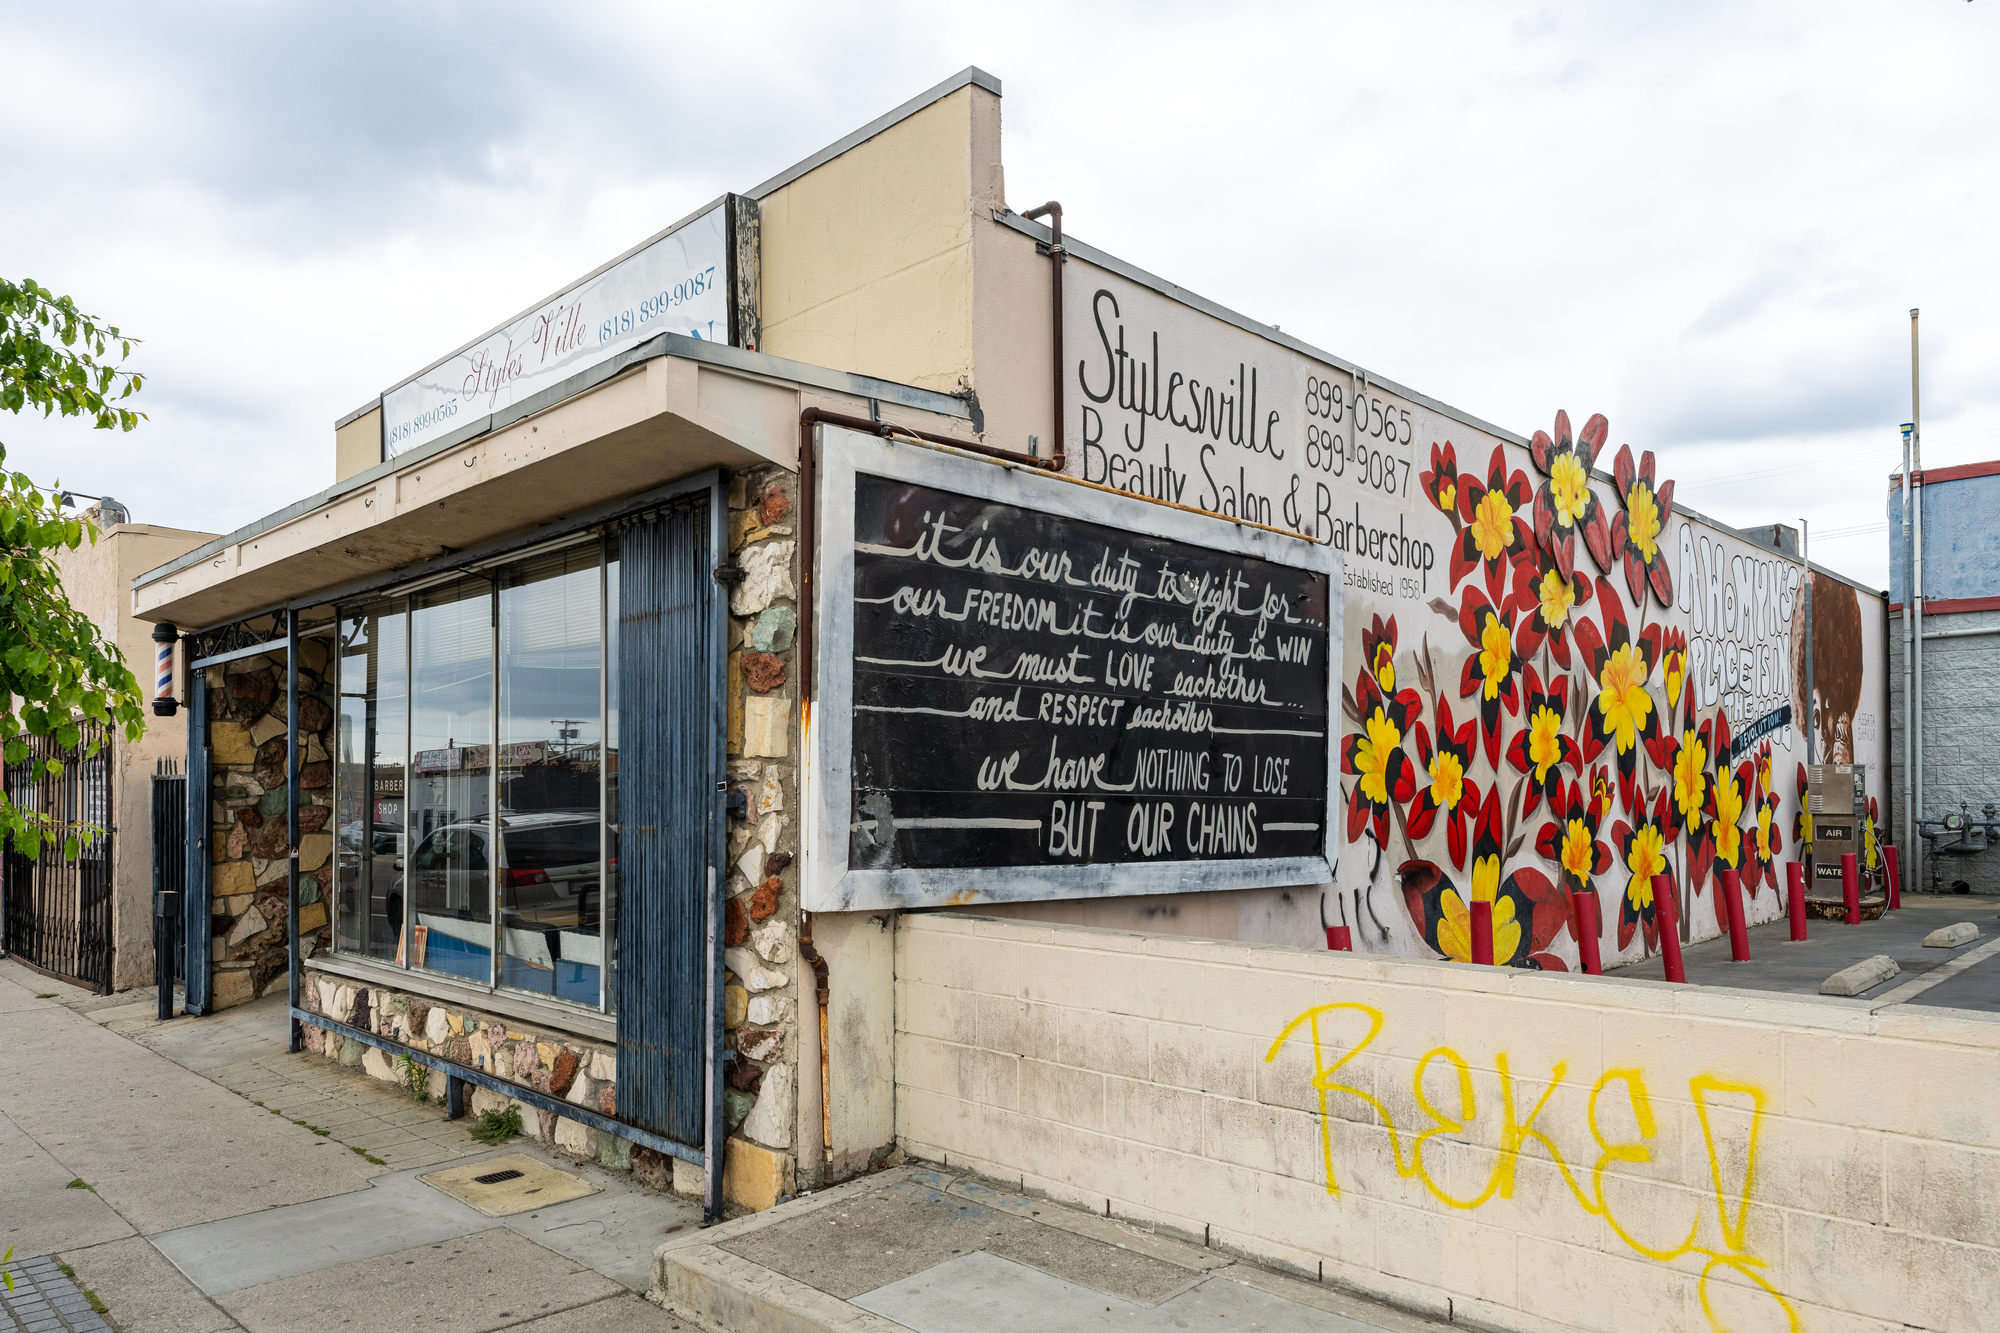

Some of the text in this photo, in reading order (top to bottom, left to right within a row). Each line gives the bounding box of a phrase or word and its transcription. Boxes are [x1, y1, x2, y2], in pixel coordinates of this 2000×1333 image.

[599, 266, 715, 346] (818) 899-9087
[462, 303, 587, 409] Styles Ville
[1079, 289, 1284, 460] Stylesville
[389, 398, 457, 447] (818) 899-0565
[1305, 376, 1412, 446] 899-0565
[1305, 424, 1411, 498] 899-9087
[1199, 443, 1272, 527] Salon
[1282, 473, 1302, 534] &
[1316, 481, 1435, 594] Barbershop
[915, 510, 963, 567] it
[967, 519, 1003, 574] is
[1020, 547, 1090, 586] our
[1090, 546, 1141, 621] duty
[1158, 560, 1185, 604] to
[1193, 568, 1250, 633] fight
[1400, 577, 1421, 600] 1958
[893, 585, 1312, 680] our FREEDOM it is our duty to WIN
[941, 643, 988, 678] we
[1012, 645, 1095, 684] must
[1105, 649, 1155, 692] LOVE
[1690, 632, 1791, 712] PLACE IS IN
[967, 686, 1033, 723] and
[1037, 692, 1125, 726] RESPECT
[1724, 691, 1753, 724] THE
[1738, 709, 1782, 751] REVOLUTION!
[374, 779, 404, 791] BARBER
[977, 750, 1020, 791] we
[1044, 734, 1106, 791] have
[1222, 753, 1243, 792] TO
[1253, 755, 1290, 795] LOSE
[378, 803, 398, 814] SHOP
[1048, 799, 1258, 857] BUT OUR CHAINS
[1825, 829, 1842, 837] AIR
[1817, 868, 1842, 876] WATE
